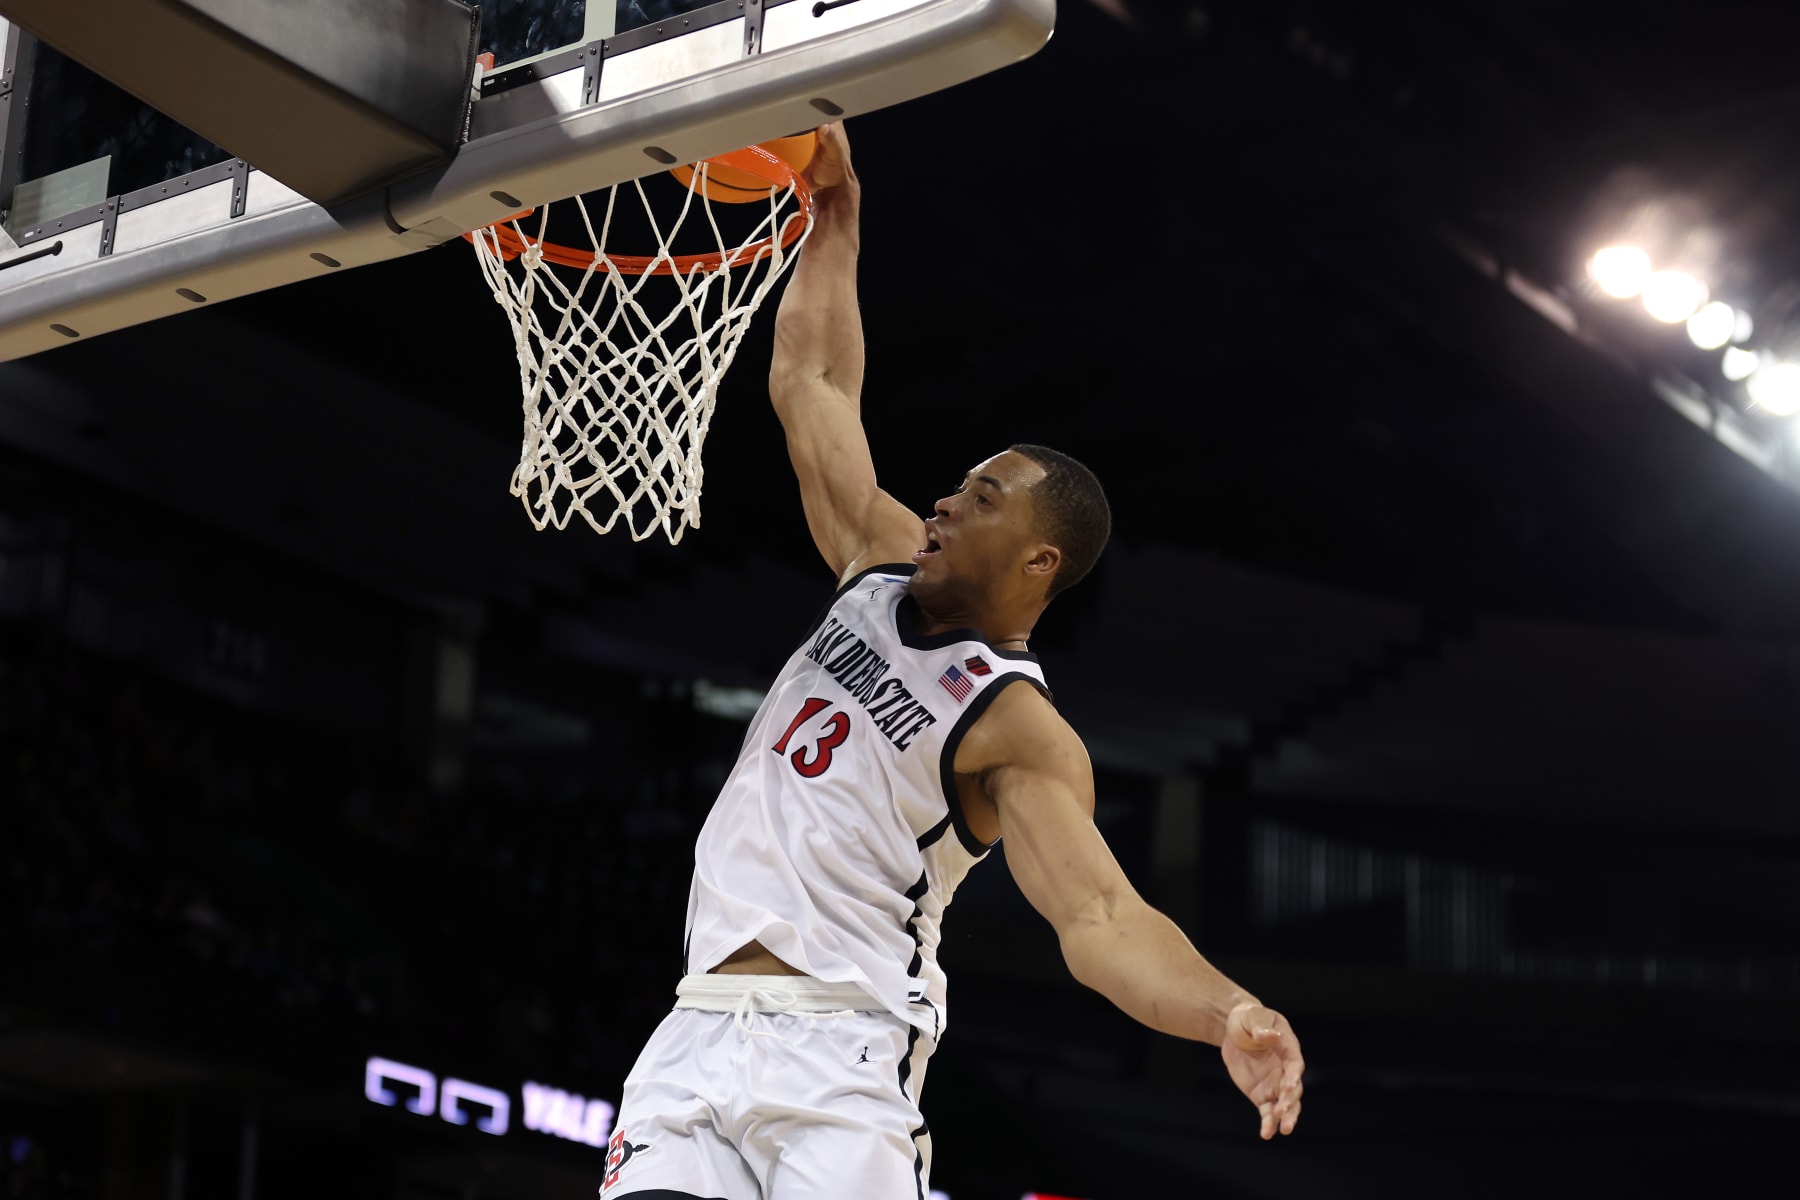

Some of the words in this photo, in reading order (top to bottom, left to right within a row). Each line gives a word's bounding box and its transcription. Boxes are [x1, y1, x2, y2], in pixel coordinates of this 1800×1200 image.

[805, 617, 856, 665] SAN
[823, 638, 891, 705] DIEGO
[771, 697, 850, 778] 13
[863, 678, 937, 752] STATE
